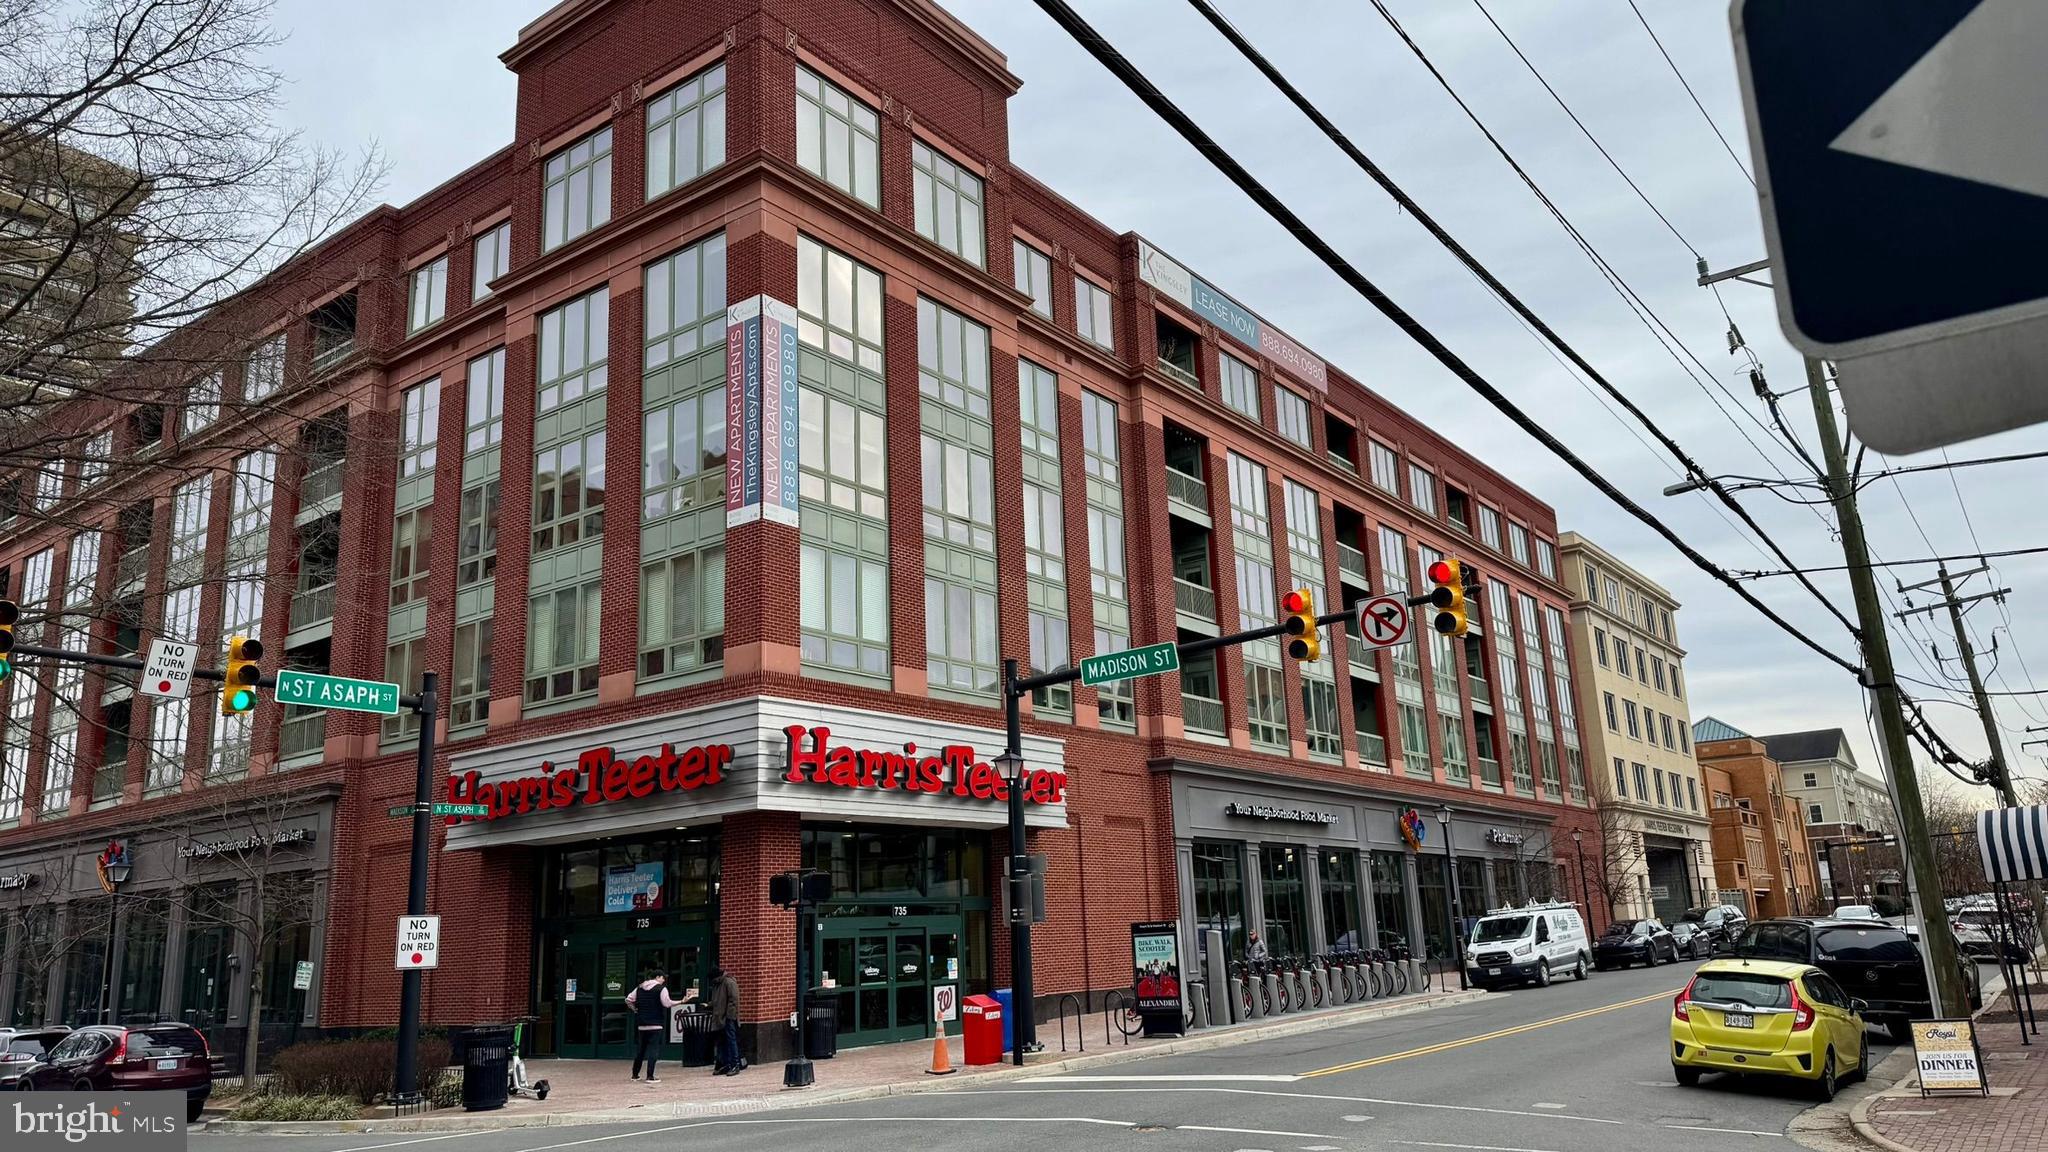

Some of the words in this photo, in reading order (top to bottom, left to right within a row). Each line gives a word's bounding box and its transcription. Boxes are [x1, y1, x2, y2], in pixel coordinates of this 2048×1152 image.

[1195, 288, 1229, 322] LEASE
[1231, 311, 1255, 338] NOW
[1262, 332, 1324, 382] 888.694.0980
[730, 329, 742, 452] APARTMENTS
[766, 325, 778, 449] APARTMENTS
[746, 323, 758, 499] TheKingsleyApts.com
[730, 459, 742, 504] NEW
[766, 452, 778, 499] NEW
[163, 645, 185, 657] NO
[158, 657, 185, 669] TURN
[1088, 654, 1147, 679] MADISON
[1154, 649, 1170, 667] ST
[148, 667, 163, 678] ON
[166, 669, 188, 681] RED
[282, 681, 289, 692] N
[293, 679, 313, 698] ST
[320, 683, 380, 706] ASAPH
[383, 693, 393, 702] ST
[783, 724, 943, 794] Harris
[445, 761, 578, 826] Harris
[578, 743, 732, 804] Teeter
[443, 805, 452, 813] ST
[454, 805, 474, 814] ASAPH
[1235, 803, 1252, 815] Your
[1253, 805, 1300, 820] Neighborhood
[1301, 811, 1316, 822] Food
[1317, 812, 1339, 824] Market
[178, 846, 194, 858] Your
[273, 829, 304, 844] Market
[608, 875, 630, 885] Harris
[631, 873, 654, 882] Teeter
[608, 886, 637, 895] Delivers
[608, 895, 625, 905] Cold
[894, 906, 907, 916] 735
[410, 919, 428, 930] NO
[637, 918, 650, 928] 735
[407, 932, 430, 941] TURN
[401, 943, 413, 952] ON
[417, 942, 435, 951] RED
[1926, 1028, 1957, 1039] Royal
[1921, 1059, 1976, 1071] DINNER
